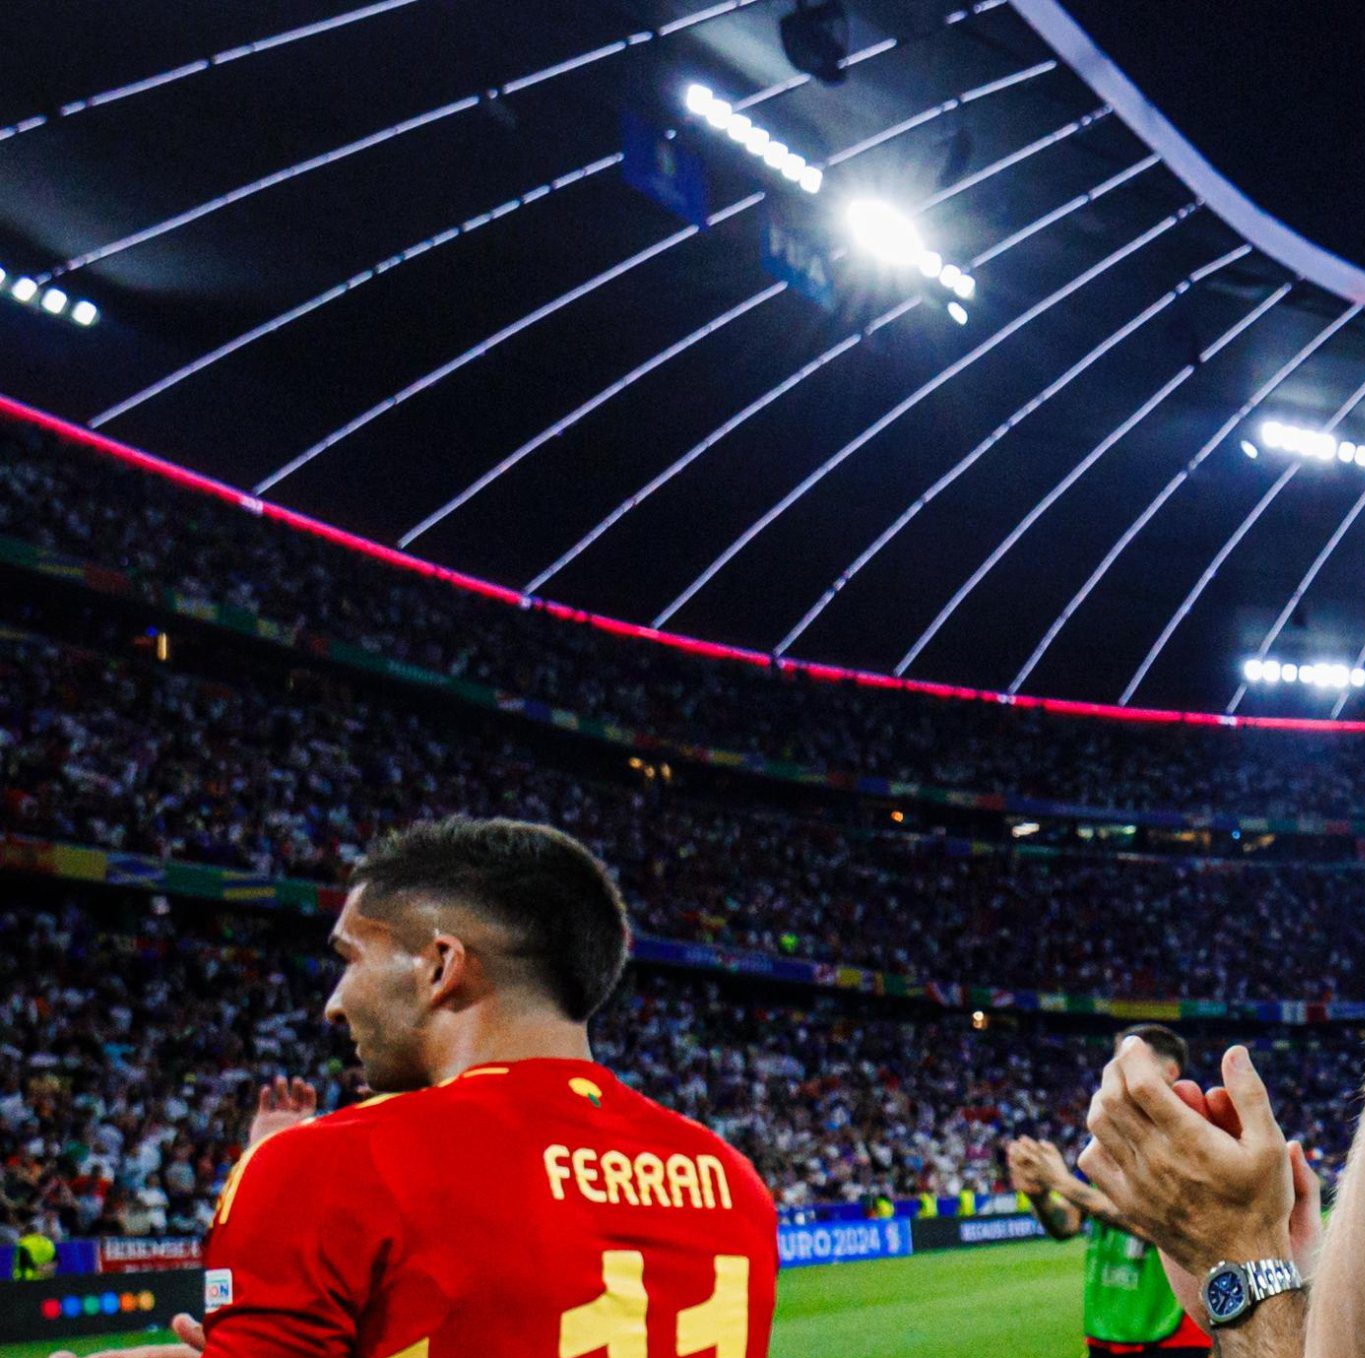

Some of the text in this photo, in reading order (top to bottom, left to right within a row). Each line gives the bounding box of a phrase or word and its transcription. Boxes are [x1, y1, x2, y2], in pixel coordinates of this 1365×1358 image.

[543, 1144, 732, 1209] FERRAN
[778, 1226, 881, 1261] URO 2024
